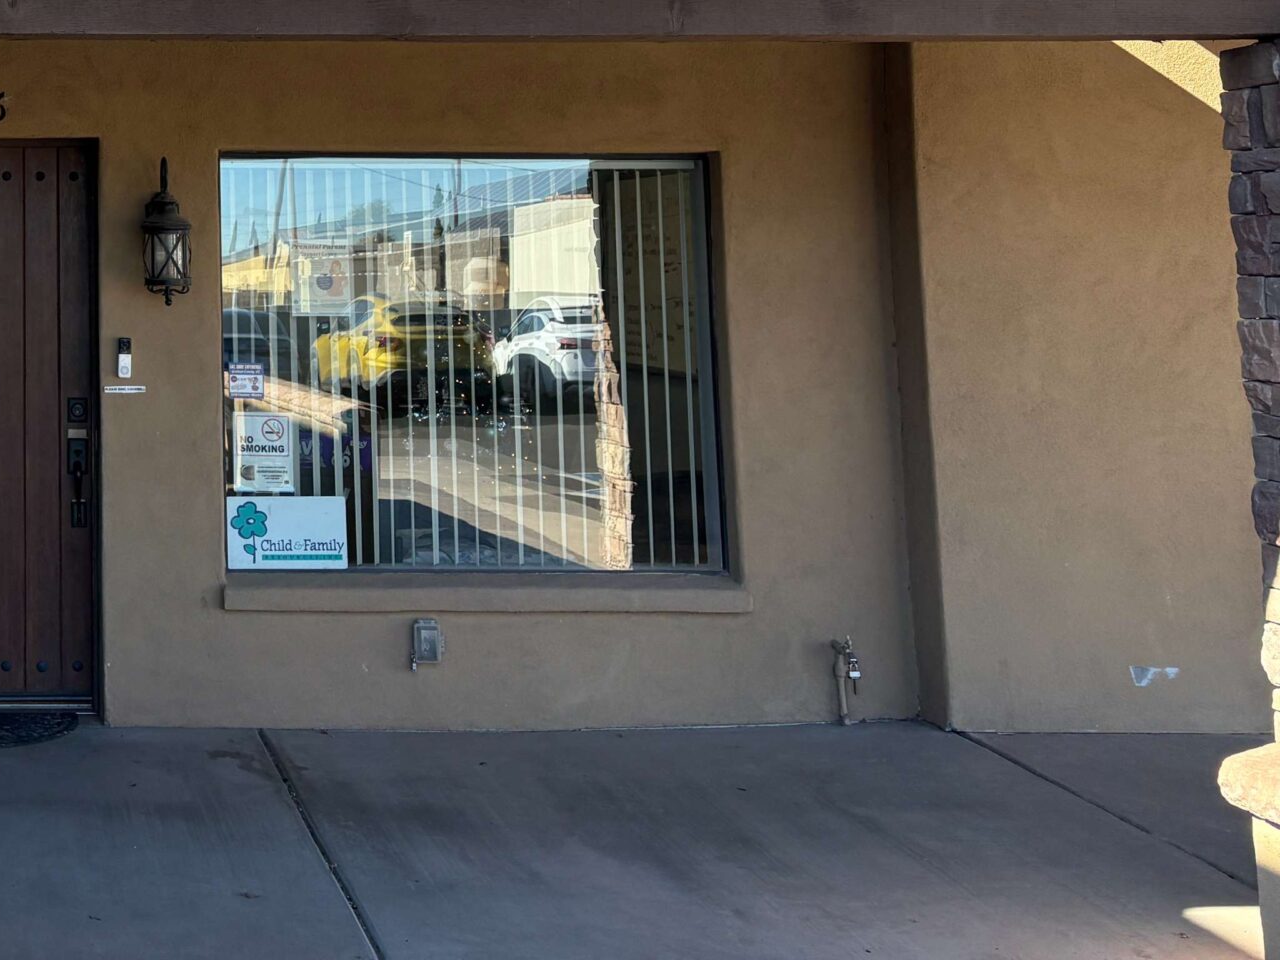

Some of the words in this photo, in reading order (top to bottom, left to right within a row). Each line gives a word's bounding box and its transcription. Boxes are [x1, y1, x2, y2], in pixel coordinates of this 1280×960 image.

[240, 435, 254, 444] NO
[240, 444, 285, 453] SMOKING
[304, 538, 345, 554] Family
